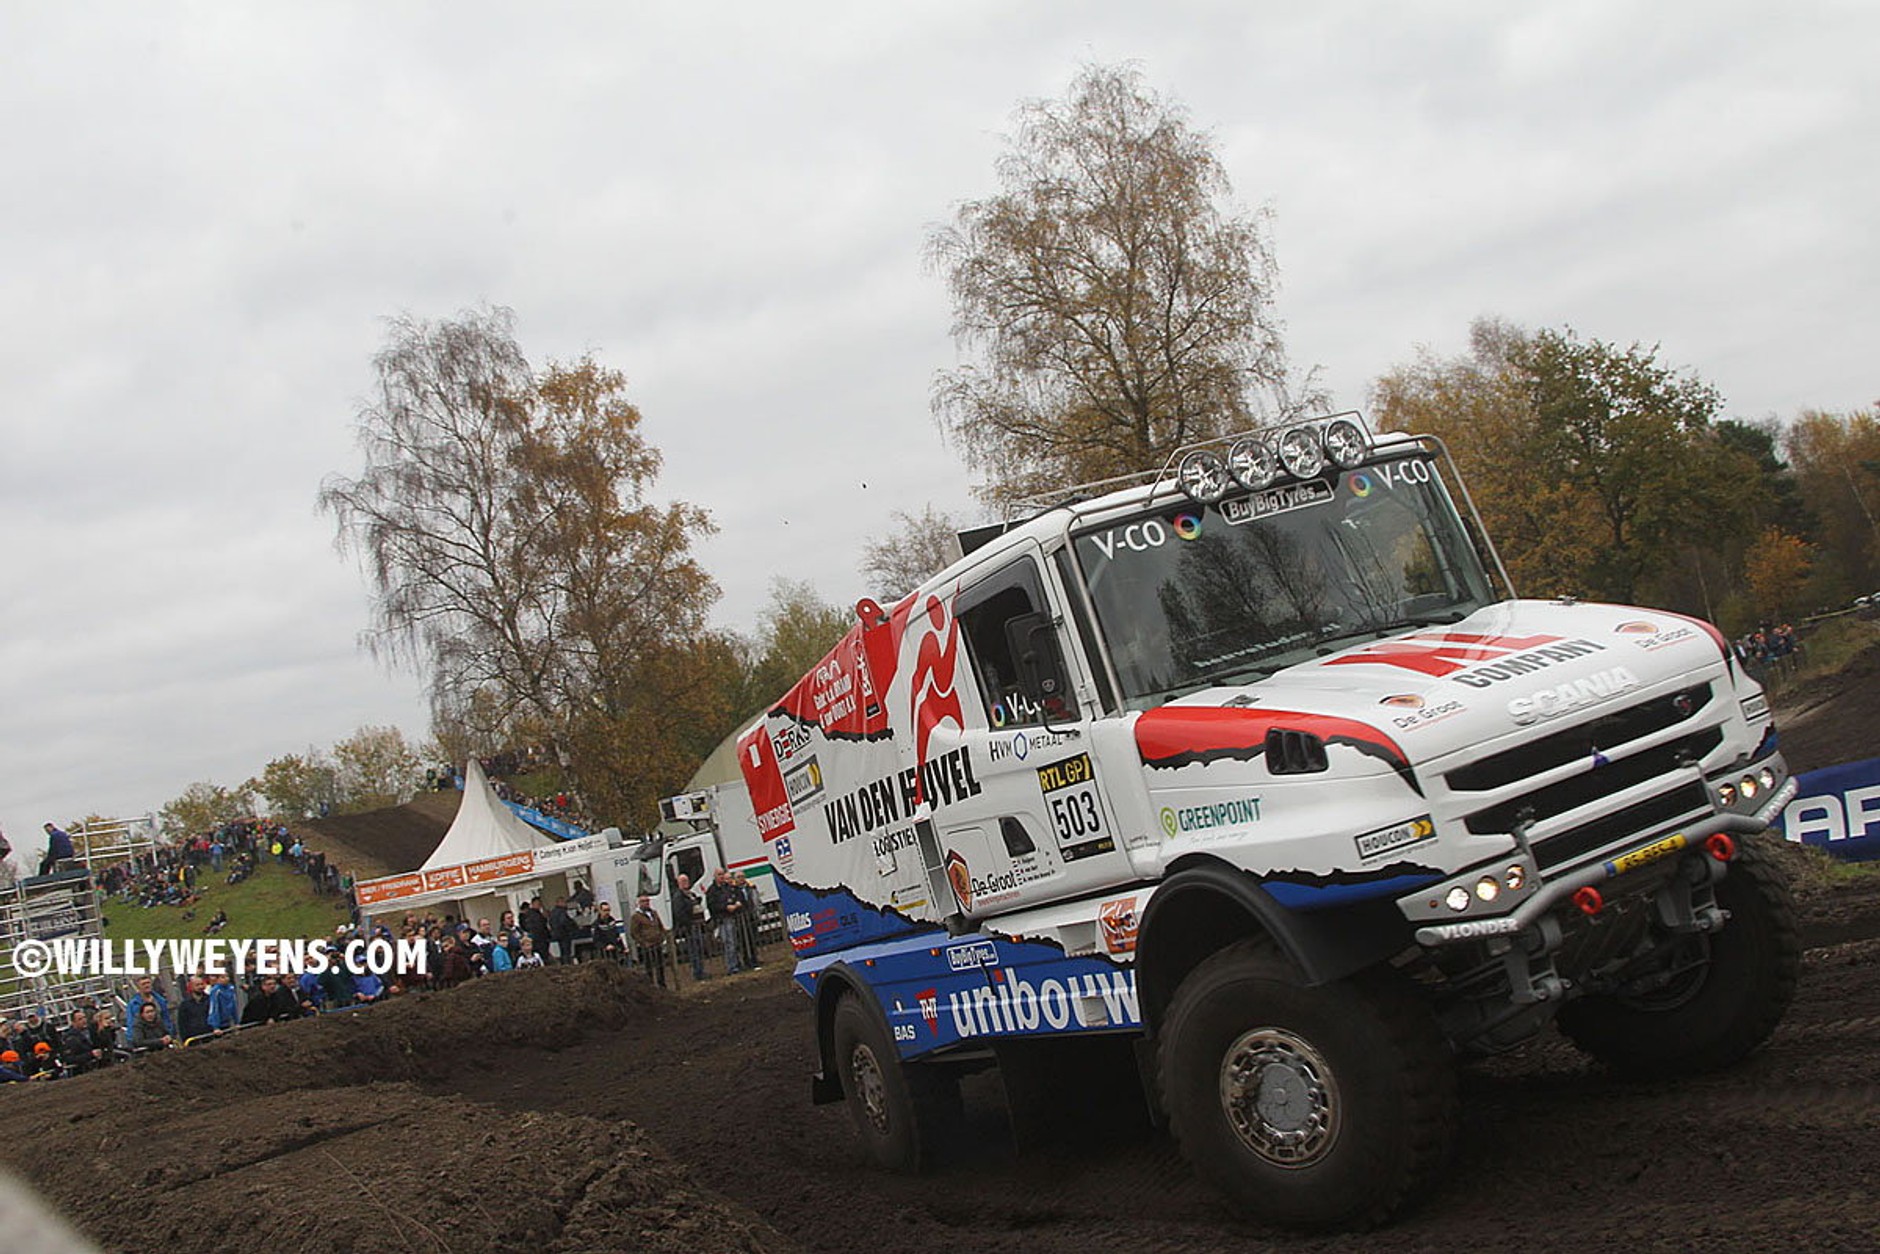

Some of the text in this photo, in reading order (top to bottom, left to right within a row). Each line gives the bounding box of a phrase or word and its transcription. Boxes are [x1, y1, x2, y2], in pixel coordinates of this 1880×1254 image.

[1373, 460, 1430, 489] V-CO
[1092, 520, 1166, 560] V-CO
[1452, 639, 1606, 688] COMPANY
[1508, 666, 1641, 726] SCANIA
[1392, 700, 1463, 729] De Groot
[988, 740, 1012, 762] HVM
[1039, 766, 1066, 791] RTL
[823, 791, 861, 845] VAN
[858, 775, 899, 832] DEN
[1052, 790, 1100, 840] 503
[1178, 797, 1261, 832] GREENPOINT
[1361, 826, 1411, 852] HOUCON
[429, 869, 461, 883] KOFFIE
[468, 855, 531, 876] HAMBURGERS
[971, 878, 988, 897] De
[987, 870, 1018, 893] Groot
[1439, 919, 1519, 940] VLONDER
[949, 967, 1141, 1038] unibouw
[893, 1024, 916, 1041] BAS
